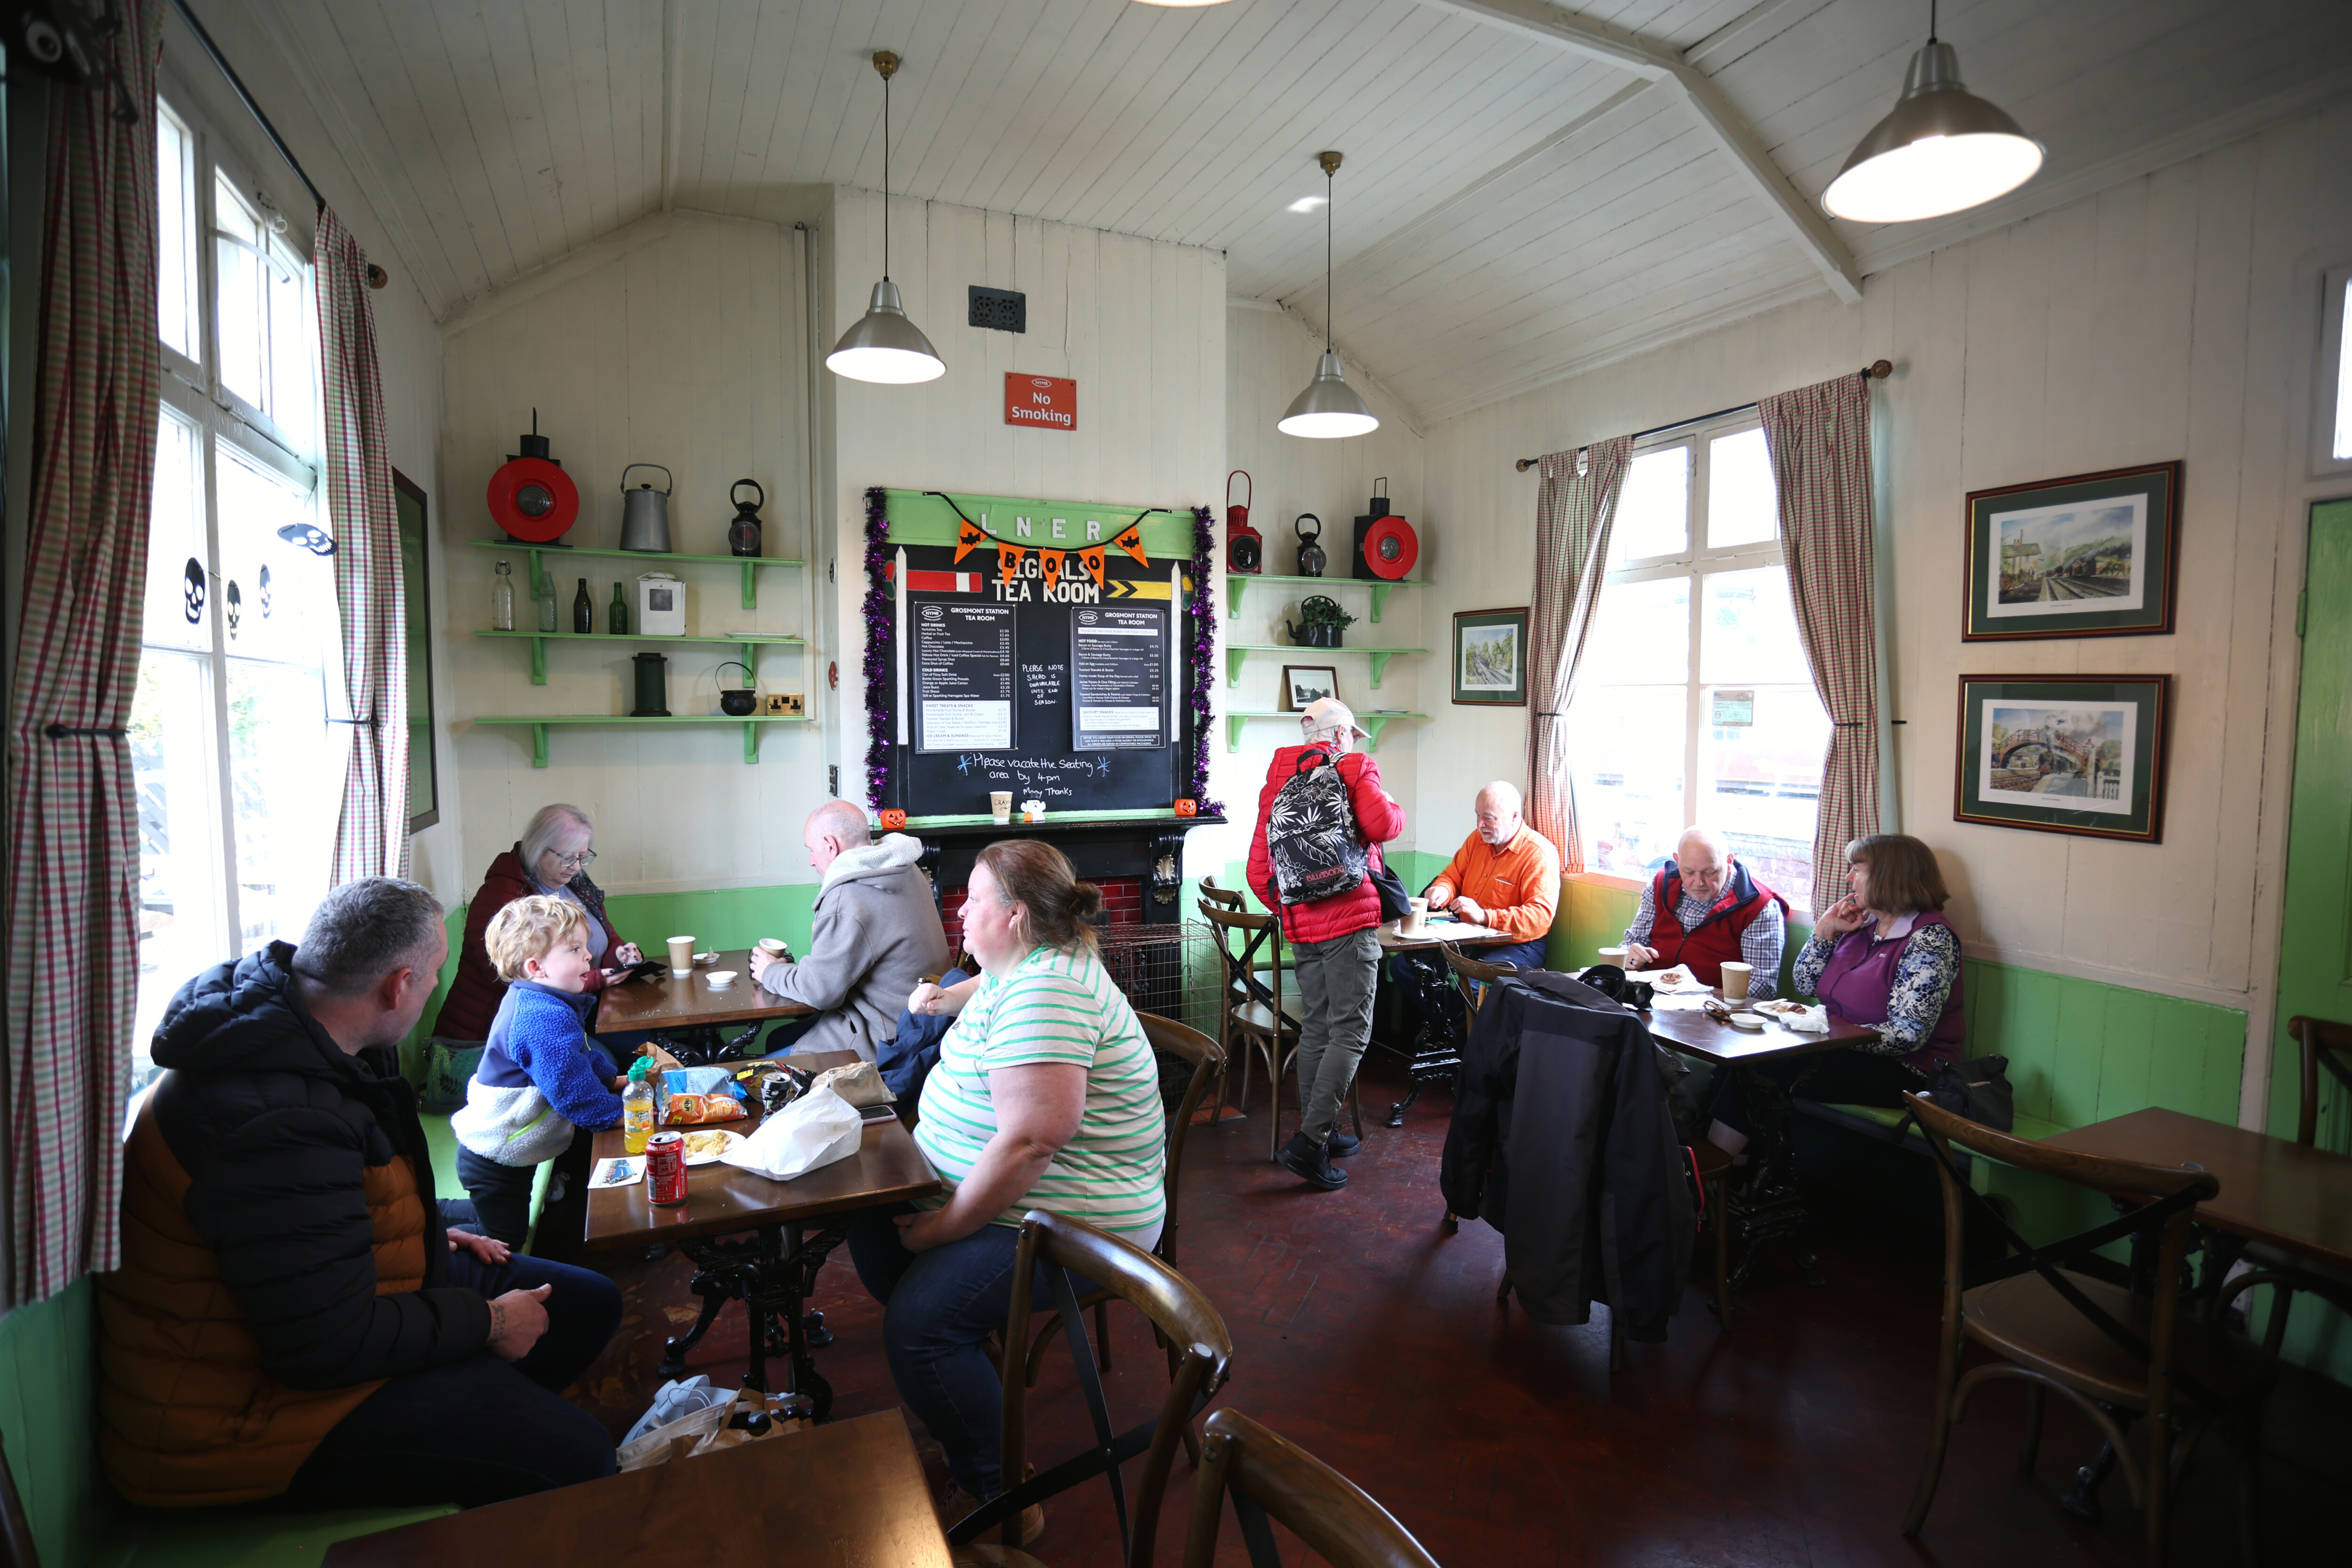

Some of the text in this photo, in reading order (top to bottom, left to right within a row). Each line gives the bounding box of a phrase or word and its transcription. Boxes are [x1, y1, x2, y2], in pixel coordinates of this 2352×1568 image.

[1033, 392, 1051, 405] No
[1012, 406, 1071, 426] Smoking
[992, 579, 1099, 604] TEA ROOM
[973, 753, 1093, 777] Please vacate the Seating
[1017, 770, 1030, 784] by
[1038, 772, 1060, 784] 4pm
[1045, 787, 1072, 796] Thanks
[1306, 866, 1344, 882] BILLABONG
